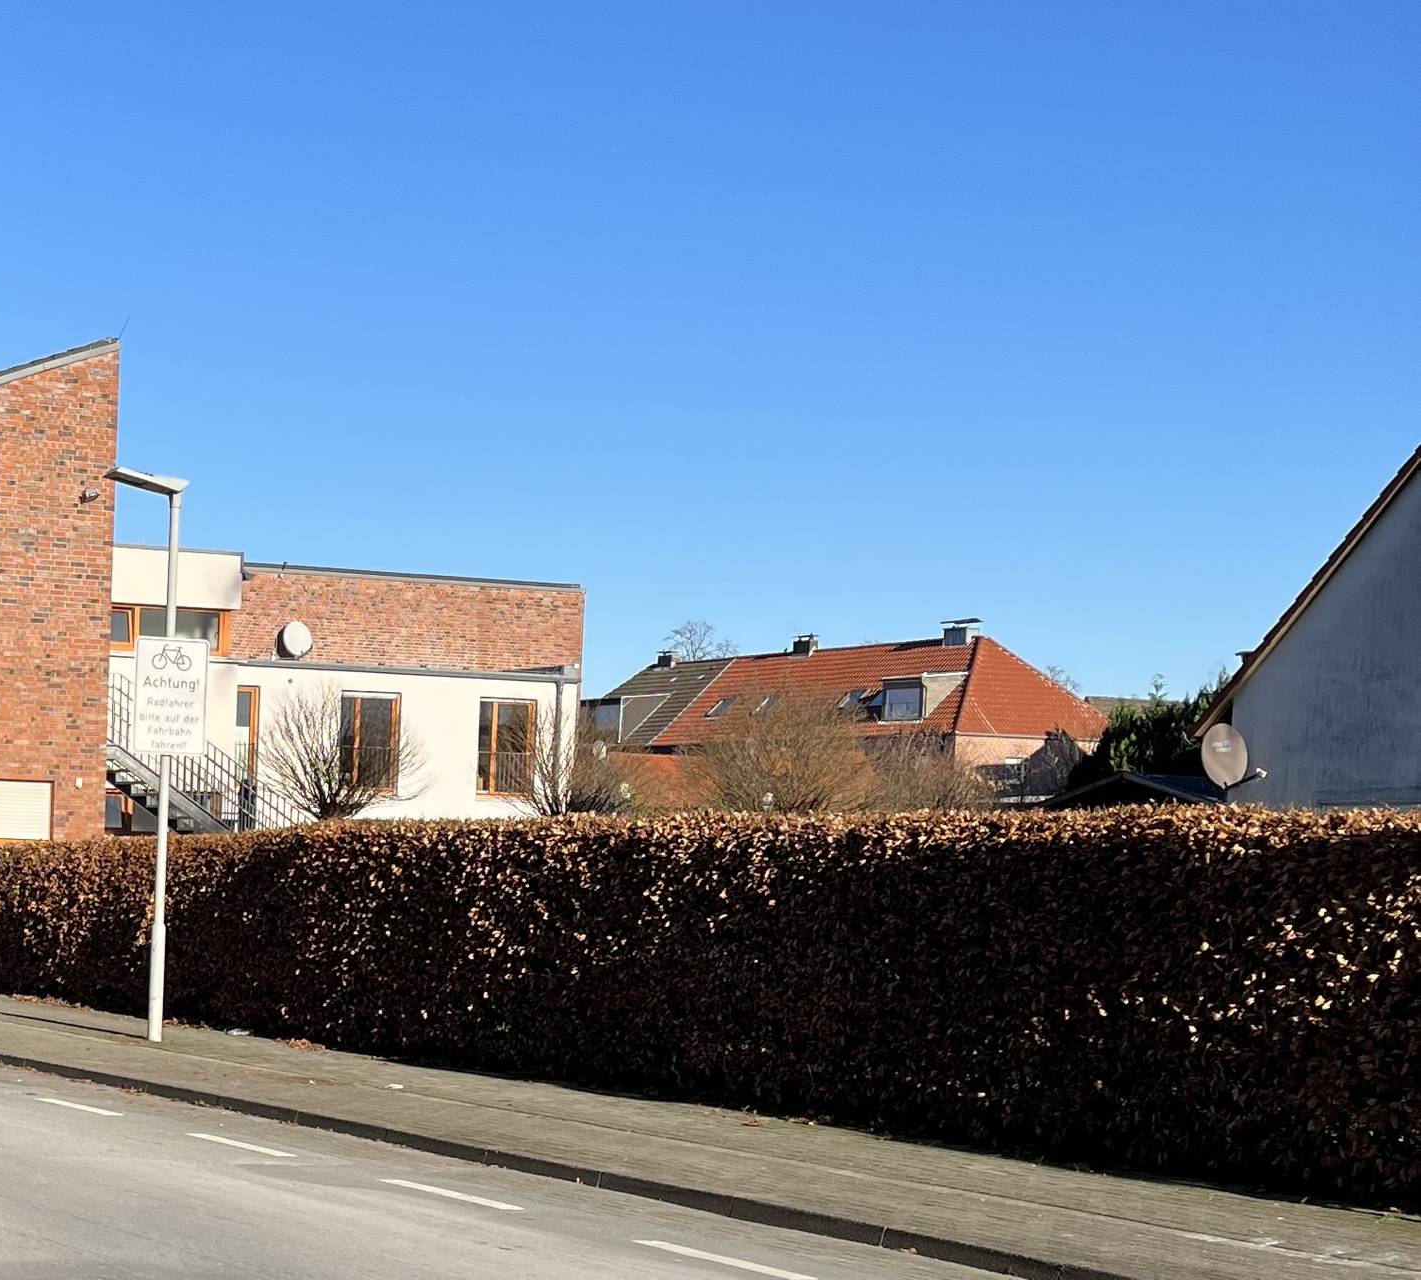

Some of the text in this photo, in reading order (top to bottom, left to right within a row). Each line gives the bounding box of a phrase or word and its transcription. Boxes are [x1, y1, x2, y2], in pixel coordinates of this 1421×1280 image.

[143, 675, 200, 693] Achtung!
[146, 696, 194, 708] Radfahrer
[139, 712, 200, 724] bitte auf der
[147, 725, 192, 736] Fahrbahn
